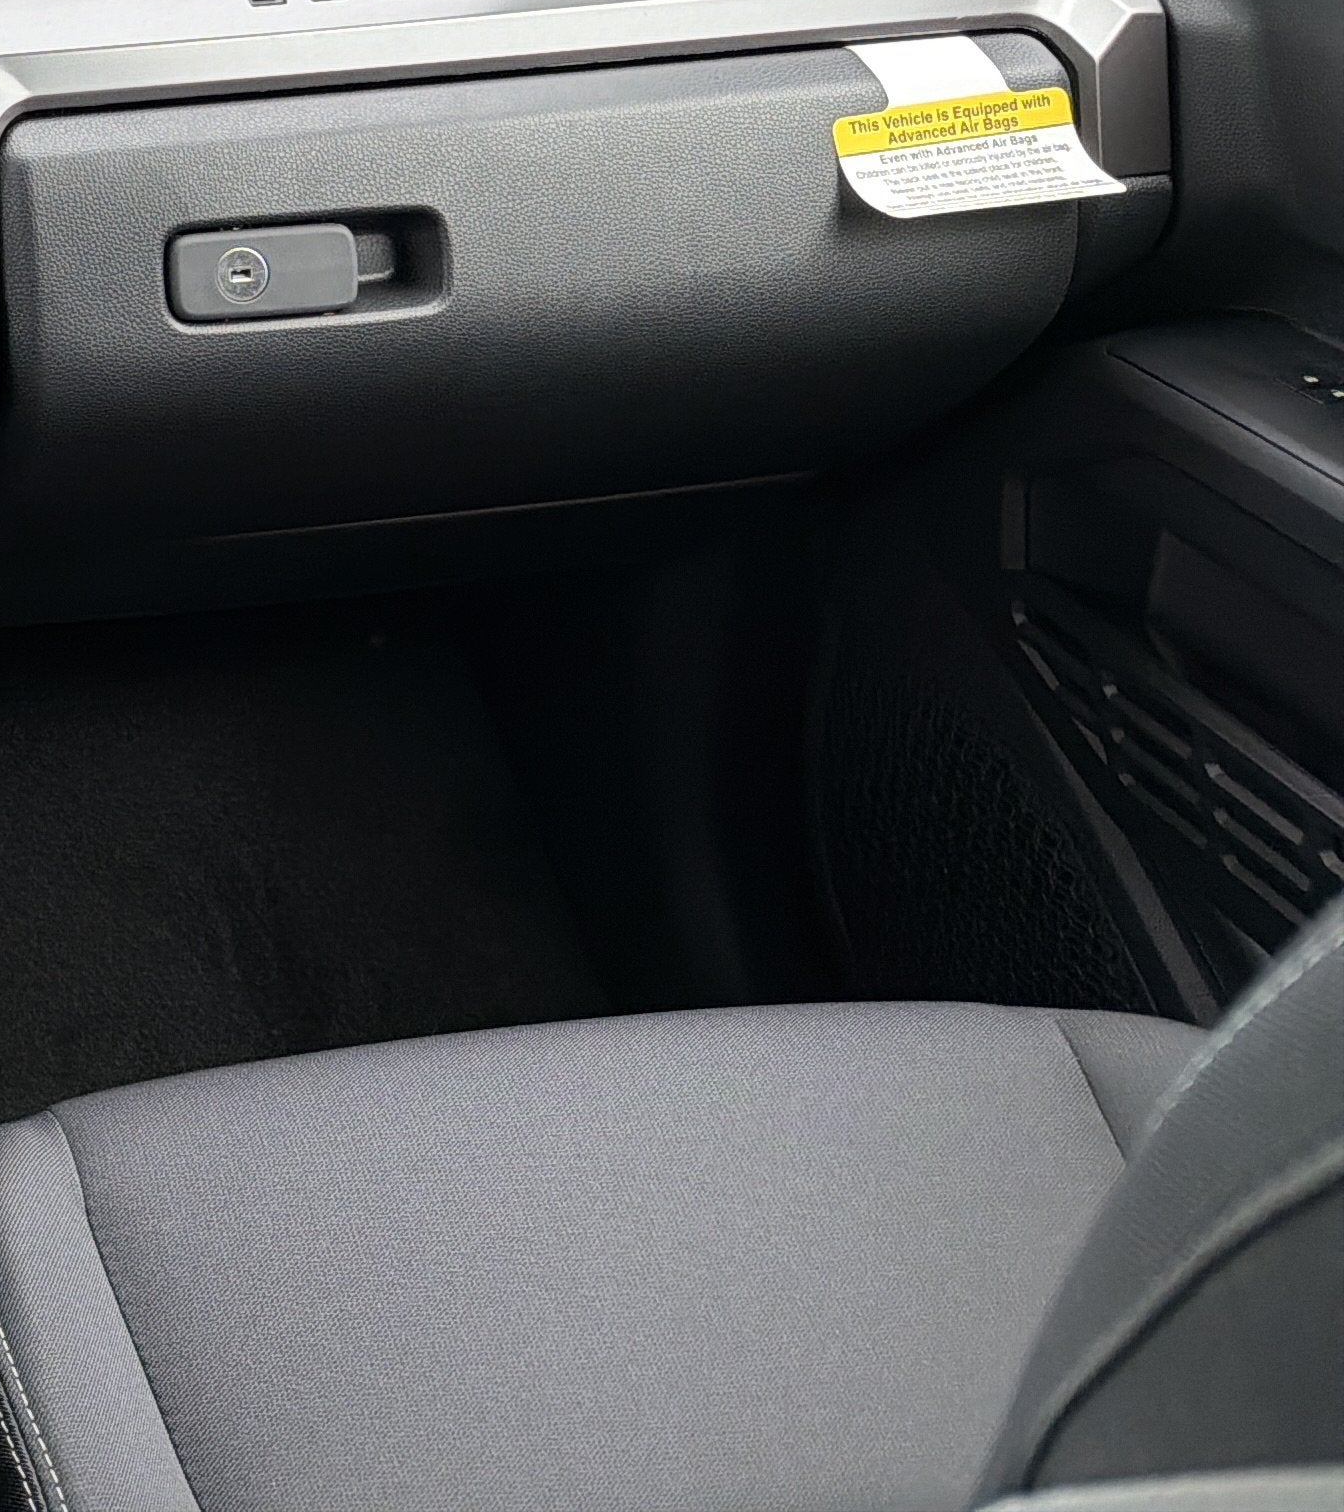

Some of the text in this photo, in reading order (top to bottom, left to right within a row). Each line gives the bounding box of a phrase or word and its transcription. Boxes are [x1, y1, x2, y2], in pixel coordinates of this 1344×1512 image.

[848, 94, 1051, 135] This Vehicle is Equipped with
[888, 115, 1019, 145] Advanced Air Bags
[879, 133, 1037, 164] Even with Advanced Air Bags
